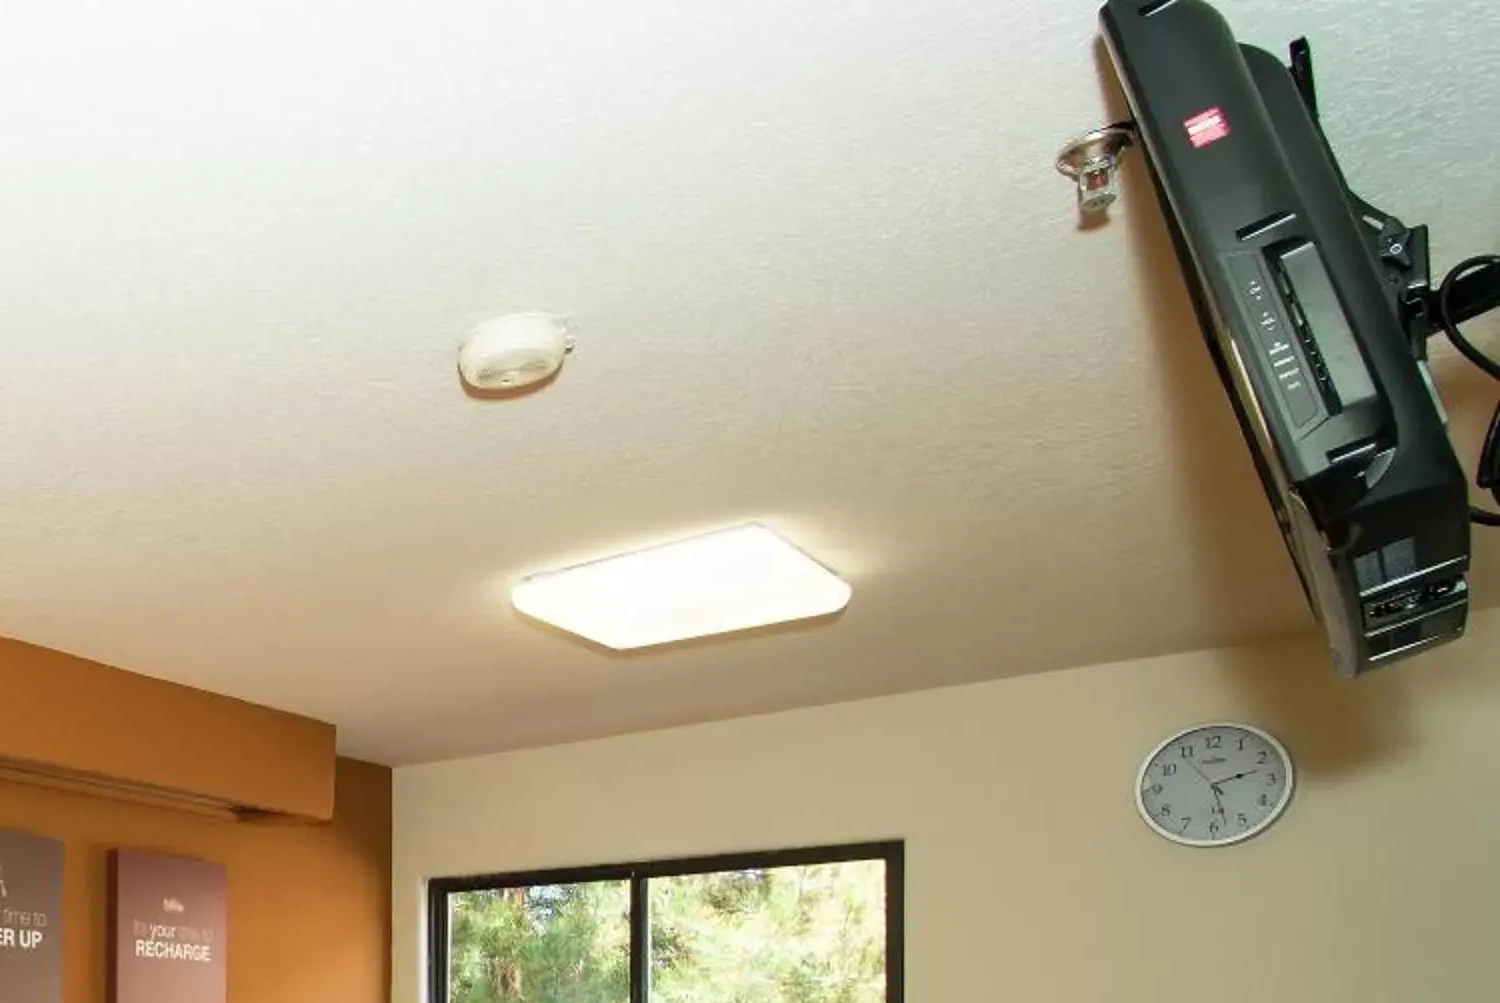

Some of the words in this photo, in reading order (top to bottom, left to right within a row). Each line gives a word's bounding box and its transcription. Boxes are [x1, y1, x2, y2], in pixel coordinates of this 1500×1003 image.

[1204, 735, 1222, 749] 12
[1236, 738, 1245, 751] 1
[1180, 745, 1194, 759] 11
[1256, 751, 1268, 765] 2
[1161, 763, 1177, 777] 10
[1265, 773, 1276, 786] 3
[1180, 816, 1192, 830] 7
[1236, 813, 1247, 826] 5
[1208, 821, 1219, 834] 6
[19, 929, 43, 948] UP
[149, 923, 176, 941] your
[135, 939, 211, 963] RECHARGE
